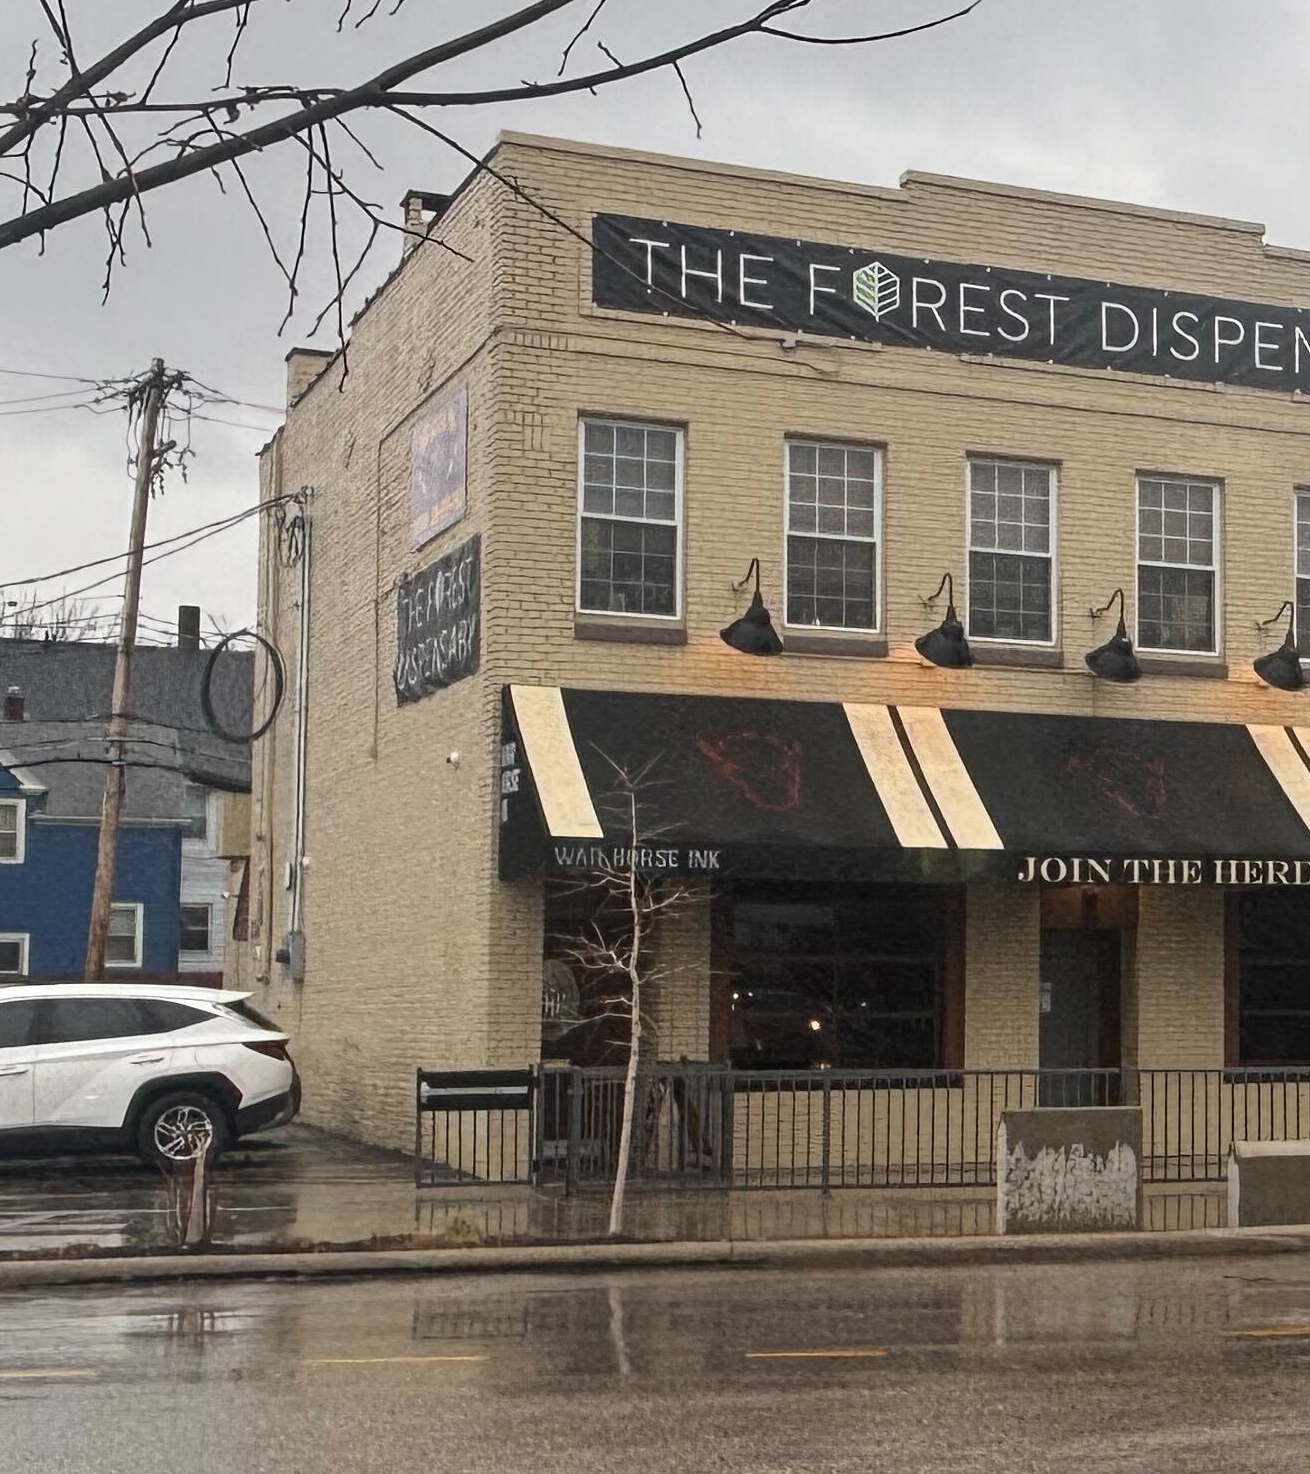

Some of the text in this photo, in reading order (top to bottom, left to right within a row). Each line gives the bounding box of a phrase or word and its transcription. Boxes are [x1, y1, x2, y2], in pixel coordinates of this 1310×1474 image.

[628, 237, 774, 310] THE
[613, 847, 679, 868] HORSE
[688, 849, 721, 869] INK
[1017, 856, 1112, 883] JOIN
[1123, 858, 1202, 884] THE
